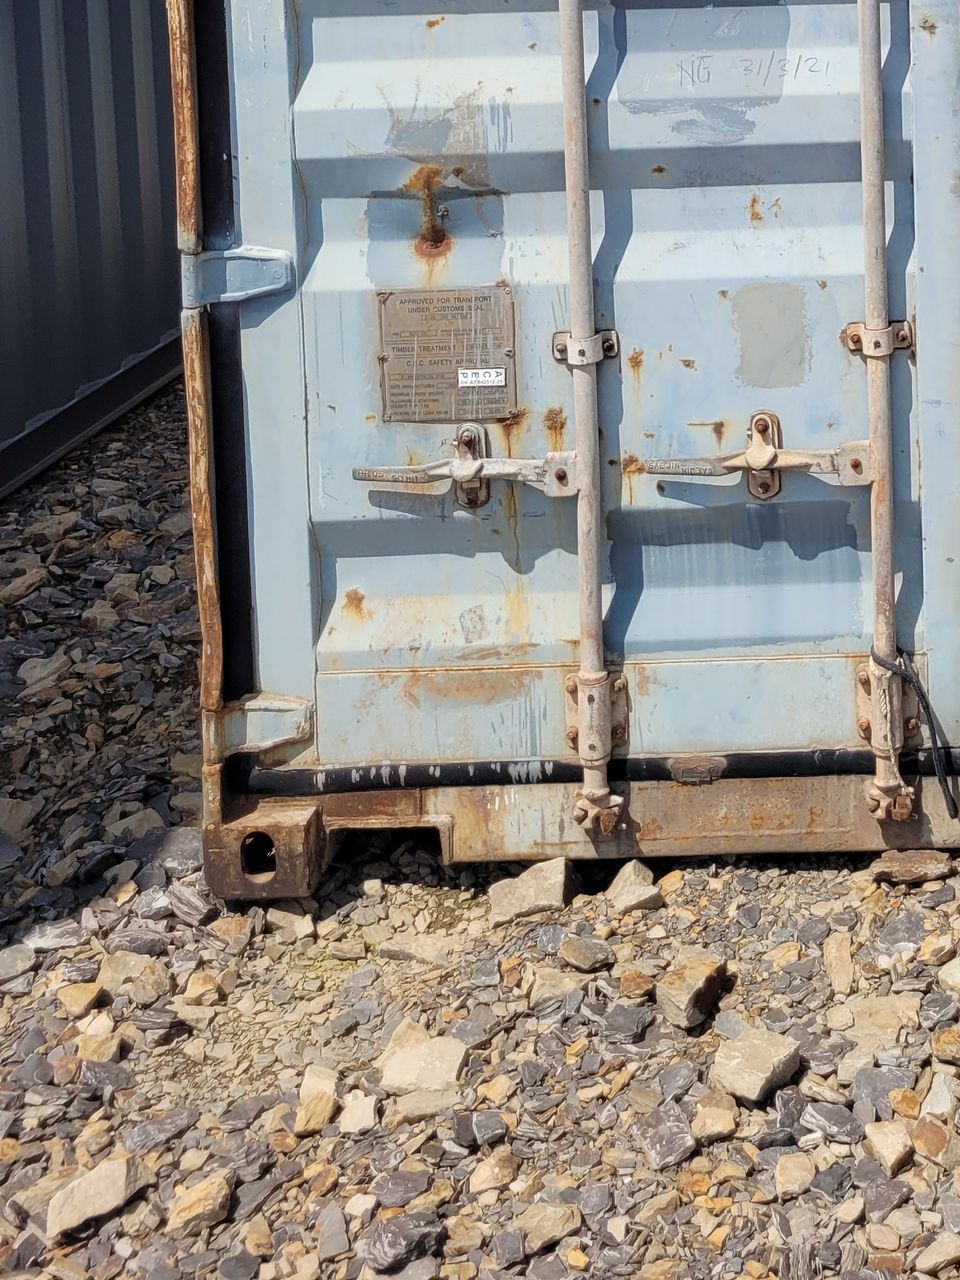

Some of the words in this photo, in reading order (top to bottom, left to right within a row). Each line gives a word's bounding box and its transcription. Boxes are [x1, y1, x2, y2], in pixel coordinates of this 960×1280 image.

[399, 298, 434, 306] APPROVED
[433, 305, 465, 313] CUSTOMS
[428, 358, 452, 366] SAFETY
[648, 461, 680, 470] SAEJIN
